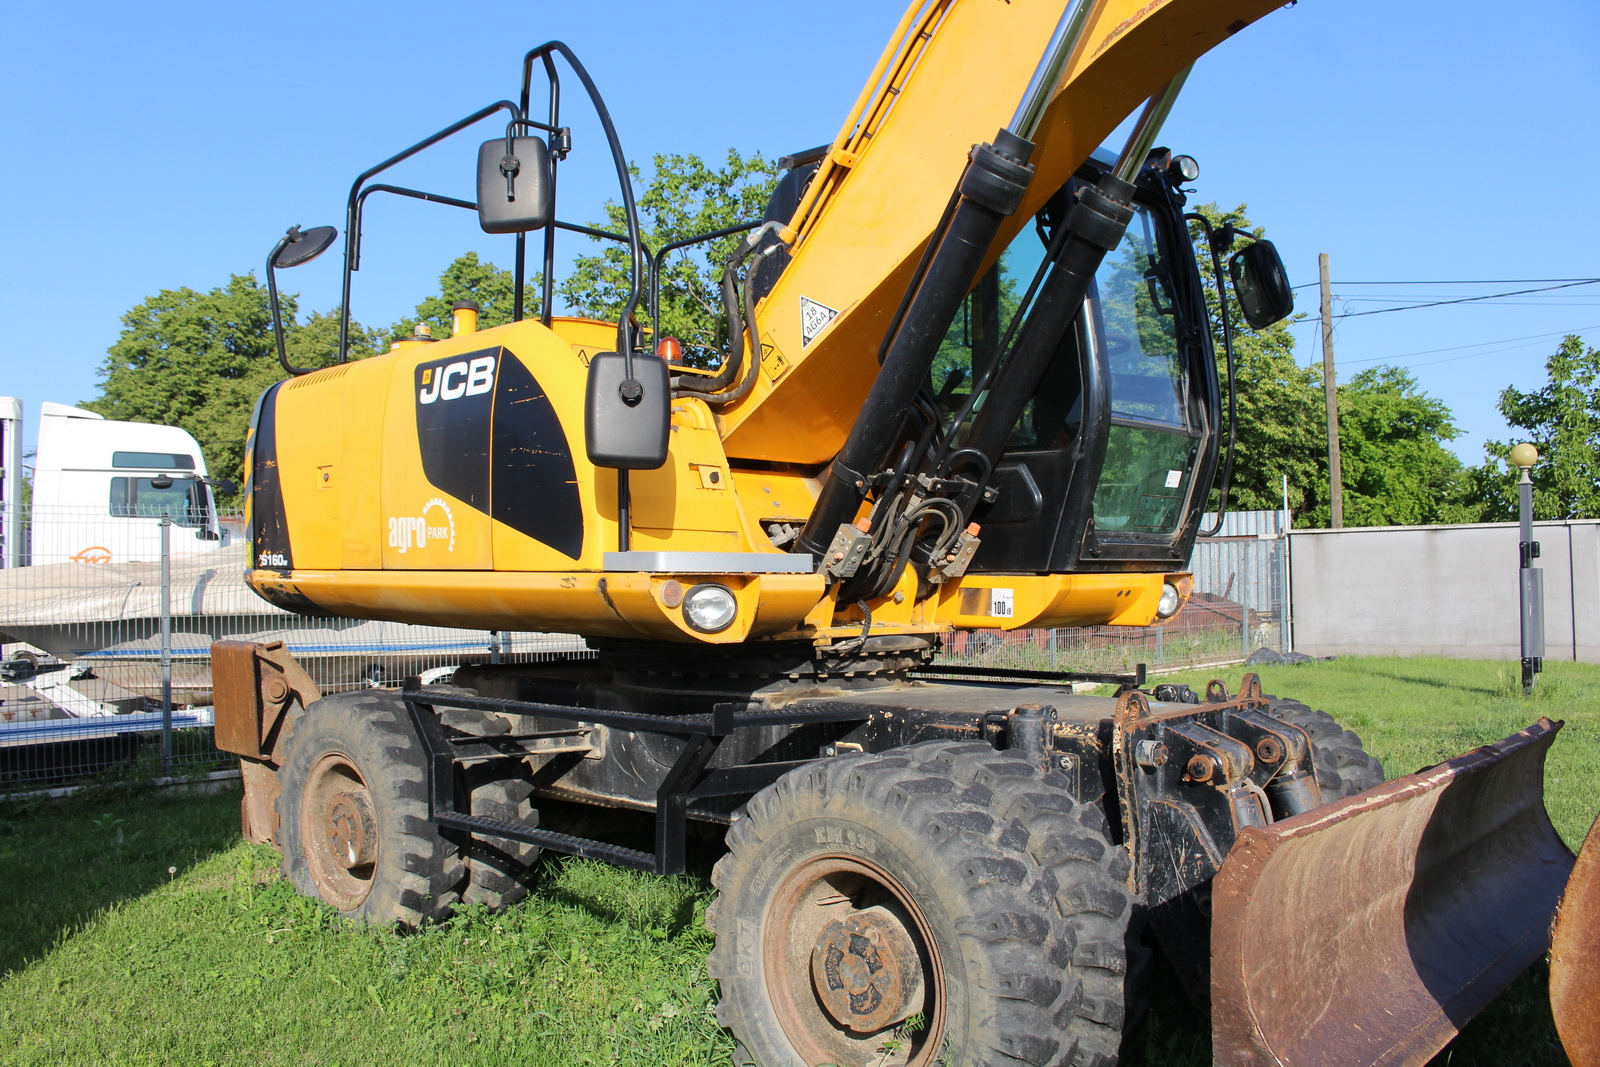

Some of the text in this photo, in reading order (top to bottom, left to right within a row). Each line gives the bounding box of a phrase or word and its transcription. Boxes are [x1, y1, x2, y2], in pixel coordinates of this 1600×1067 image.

[805, 306, 817, 321] 18
[419, 355, 496, 405] JCB
[388, 516, 449, 553] agro PARK
[994, 601, 1006, 615] 100
[815, 826, 843, 844] EM
